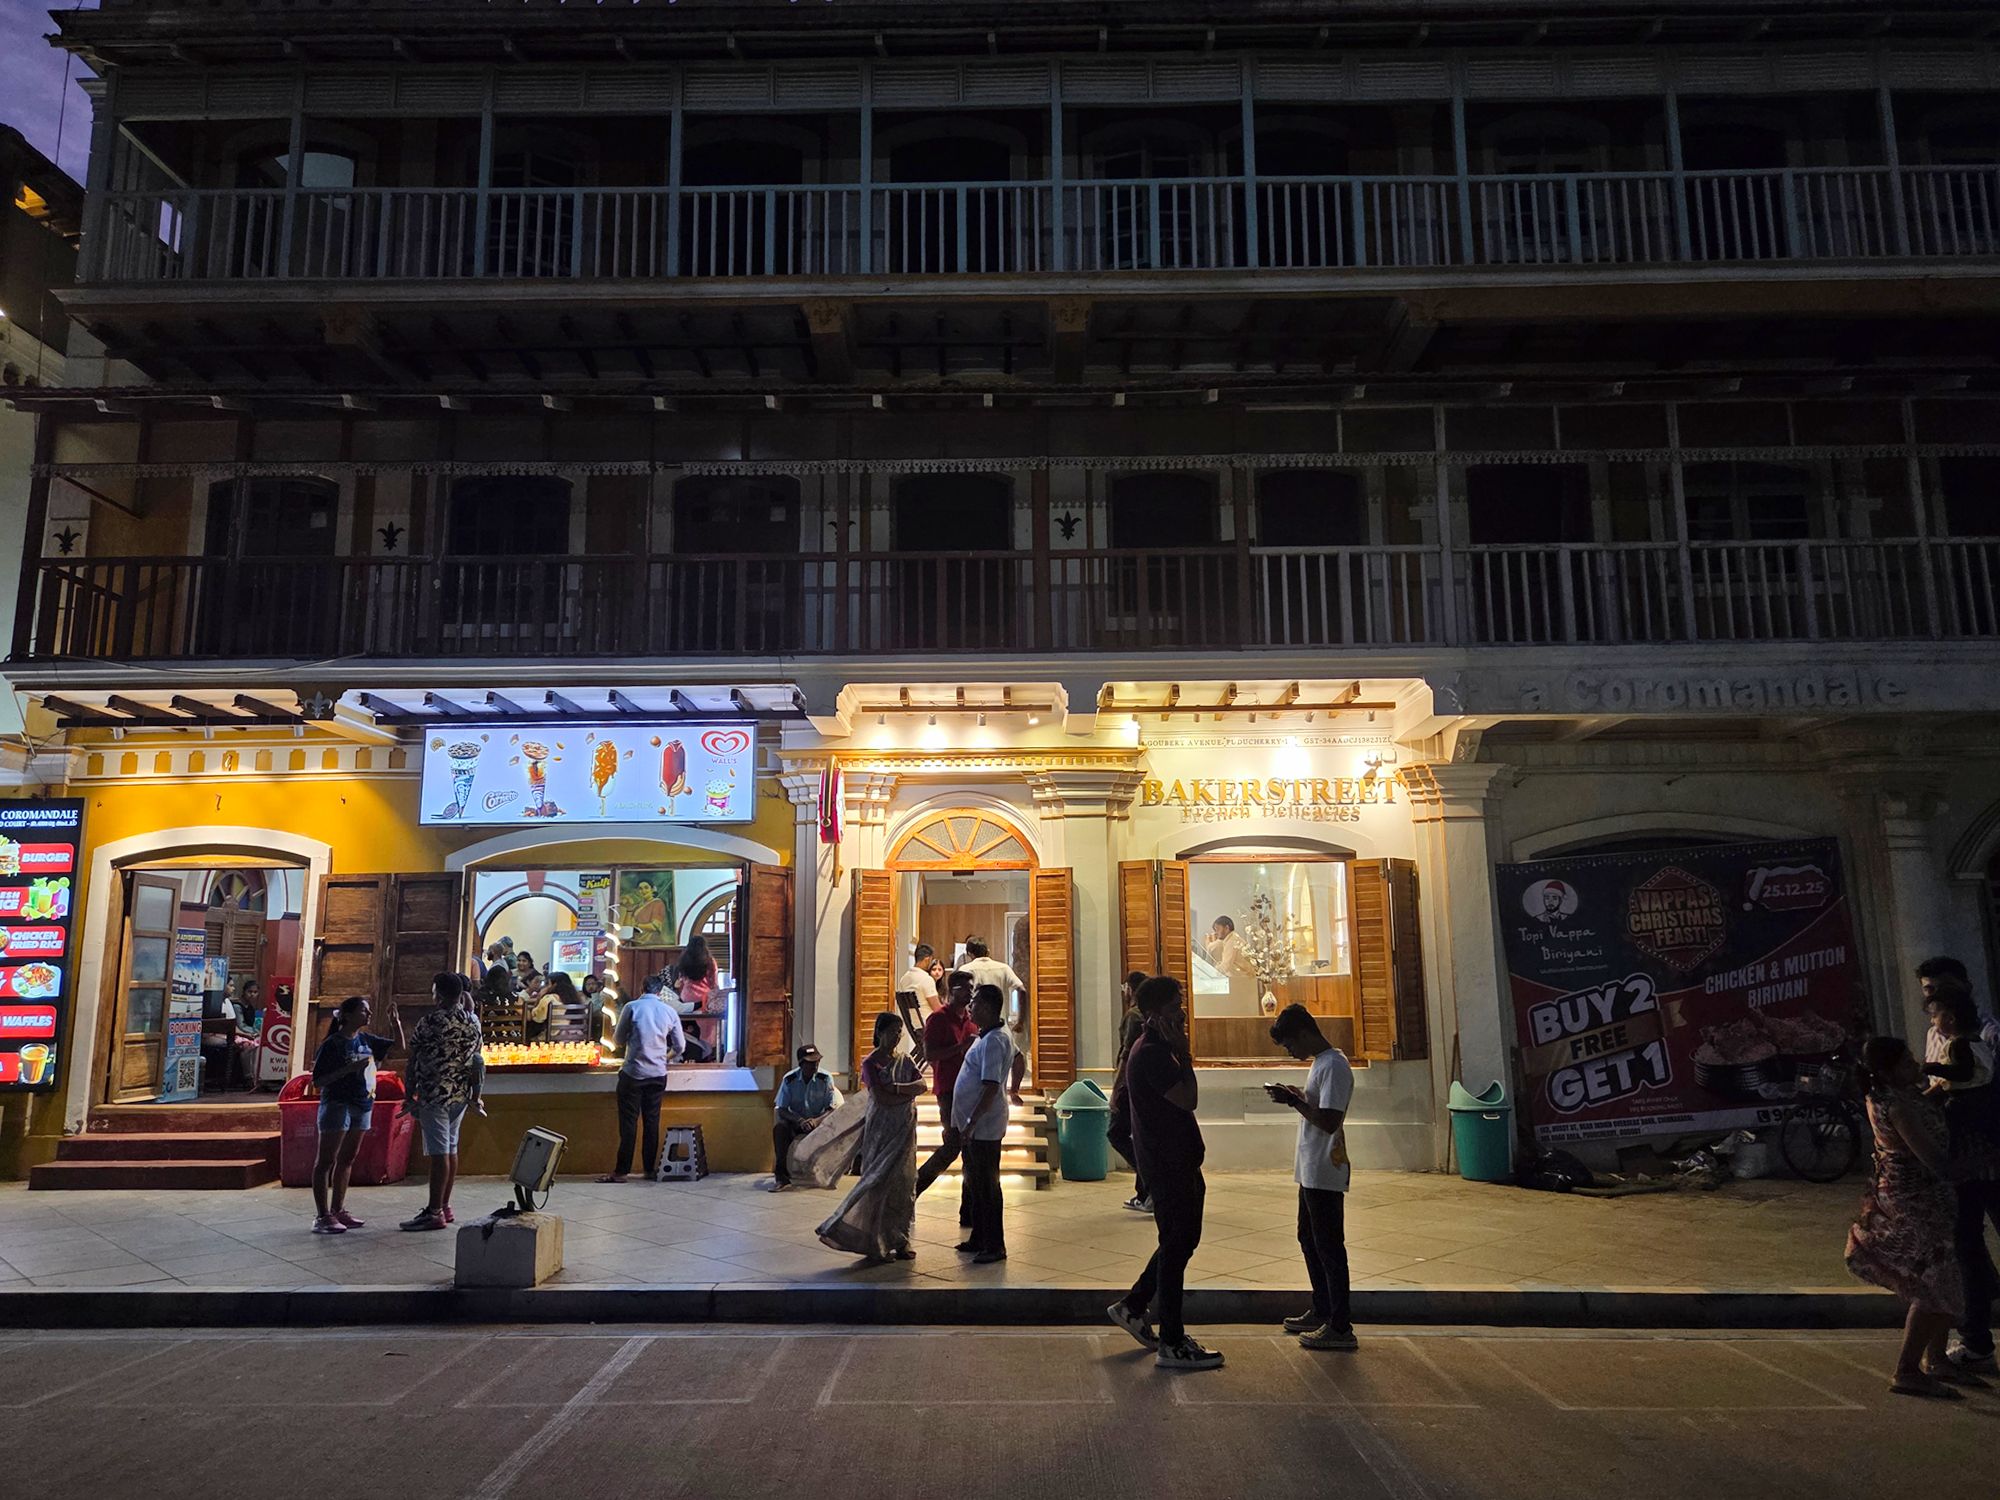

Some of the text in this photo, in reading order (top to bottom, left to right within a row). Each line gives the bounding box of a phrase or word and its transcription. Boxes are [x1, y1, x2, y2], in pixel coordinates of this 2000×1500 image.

[1565, 669, 1907, 712] Coromandale
[1141, 778, 1400, 806] BAKERSTREET
[1, 810, 78, 820] COROMANDALE
[21, 853, 70, 864] BURGER
[1637, 885, 1710, 911] VAPPAS
[1762, 881, 1824, 899] 25.12.25
[1629, 907, 1723, 933] CHRISTMAS
[10, 940, 63, 949] FRIED RICE
[11, 931, 58, 941] CHICKEN
[1518, 925, 1596, 945] Topi Vappa
[1655, 927, 1708, 946] FEAST!
[1705, 945, 1846, 994] CHICKEN & MUTTON
[1748, 977, 1809, 1009] BIRIYANI
[3, 1016, 53, 1027] WAFFLES
[1533, 978, 1656, 1044] BUY 2
[169, 1021, 202, 1035] BOOKING
[1570, 1025, 1629, 1060] FREE
[1552, 1040, 1667, 1108] GET 1
